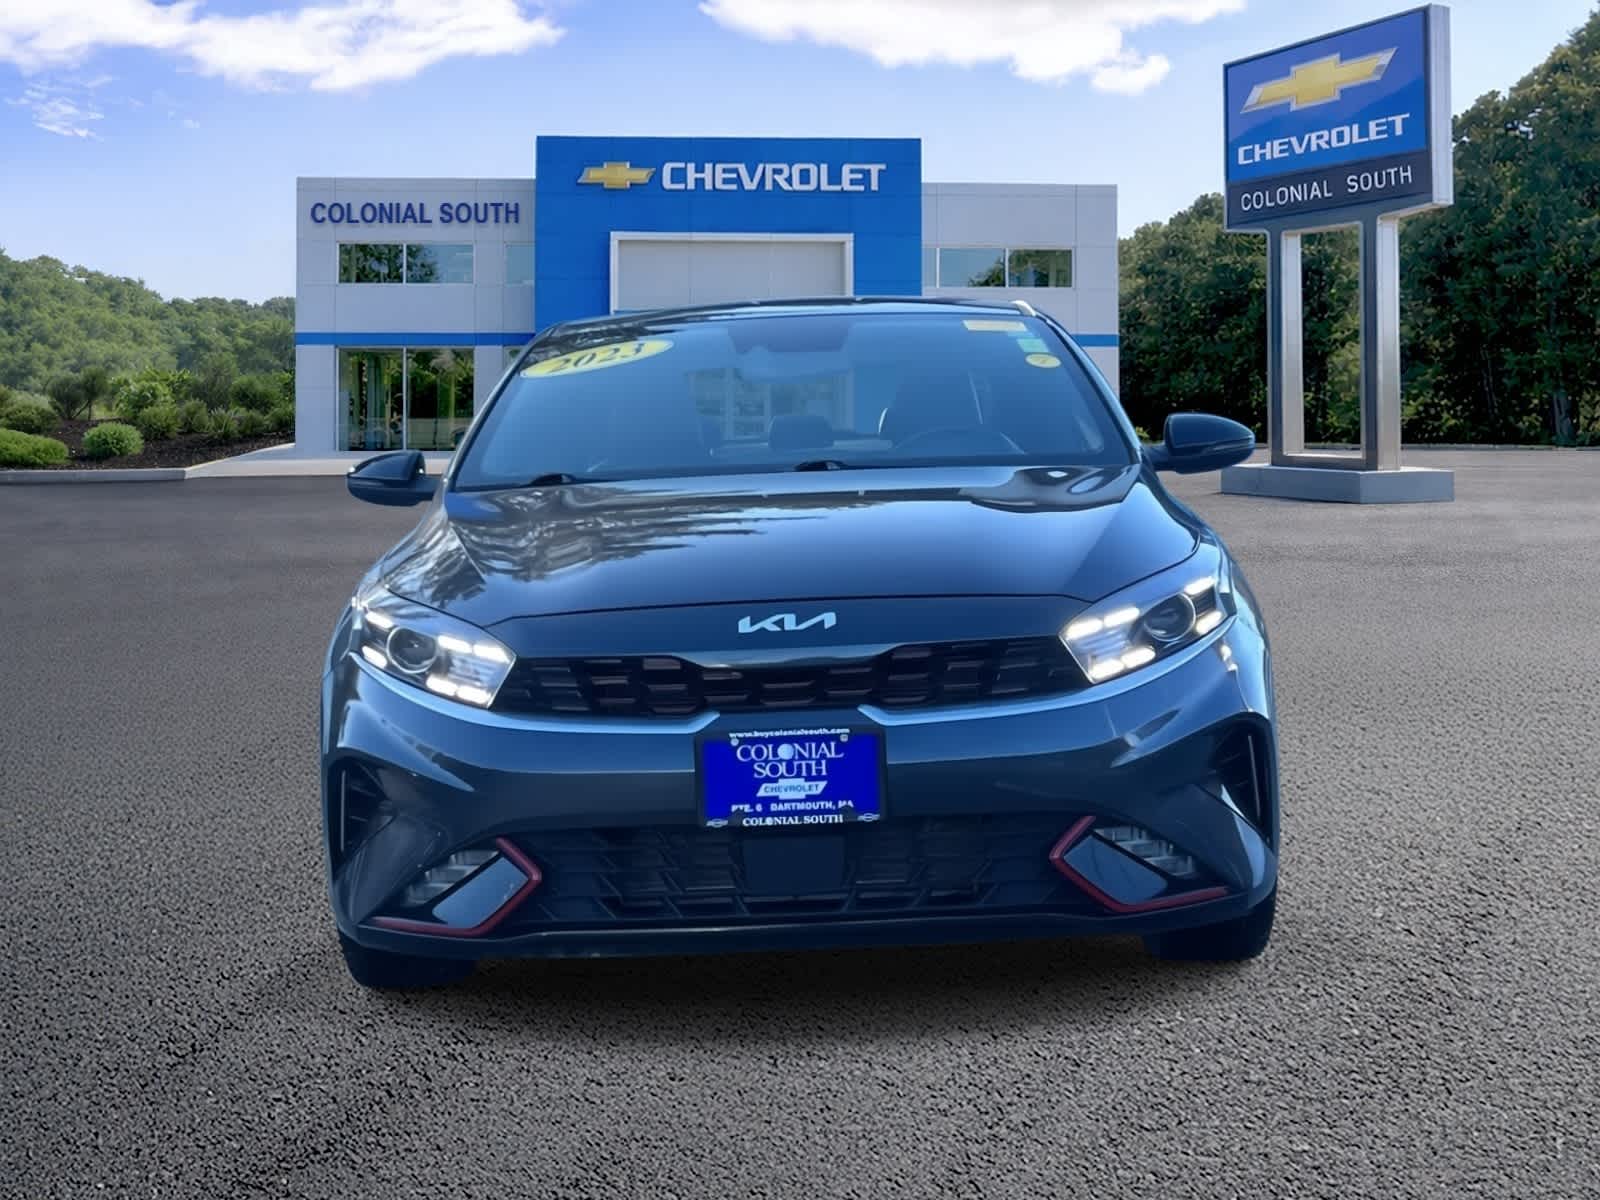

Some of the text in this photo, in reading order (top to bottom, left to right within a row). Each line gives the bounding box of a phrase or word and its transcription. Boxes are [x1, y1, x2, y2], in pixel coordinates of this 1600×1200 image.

[1237, 112, 1410, 165] CHEVROLET
[662, 162, 886, 192] CHEVROLET
[1240, 165, 1412, 211] COLONIAL SOUTH
[310, 202, 520, 224] COLONIAL SOUTH
[737, 611, 837, 633] KIA
[728, 728, 850, 738] www.buycolonialsouth.com
[736, 742, 844, 762] COLONIAL
[753, 760, 828, 778] SOUTH
[763, 783, 820, 794] CHEVROLET
[770, 800, 836, 811] DARTMOUTH,
[742, 813, 844, 827] COLONIAL SOUTH
